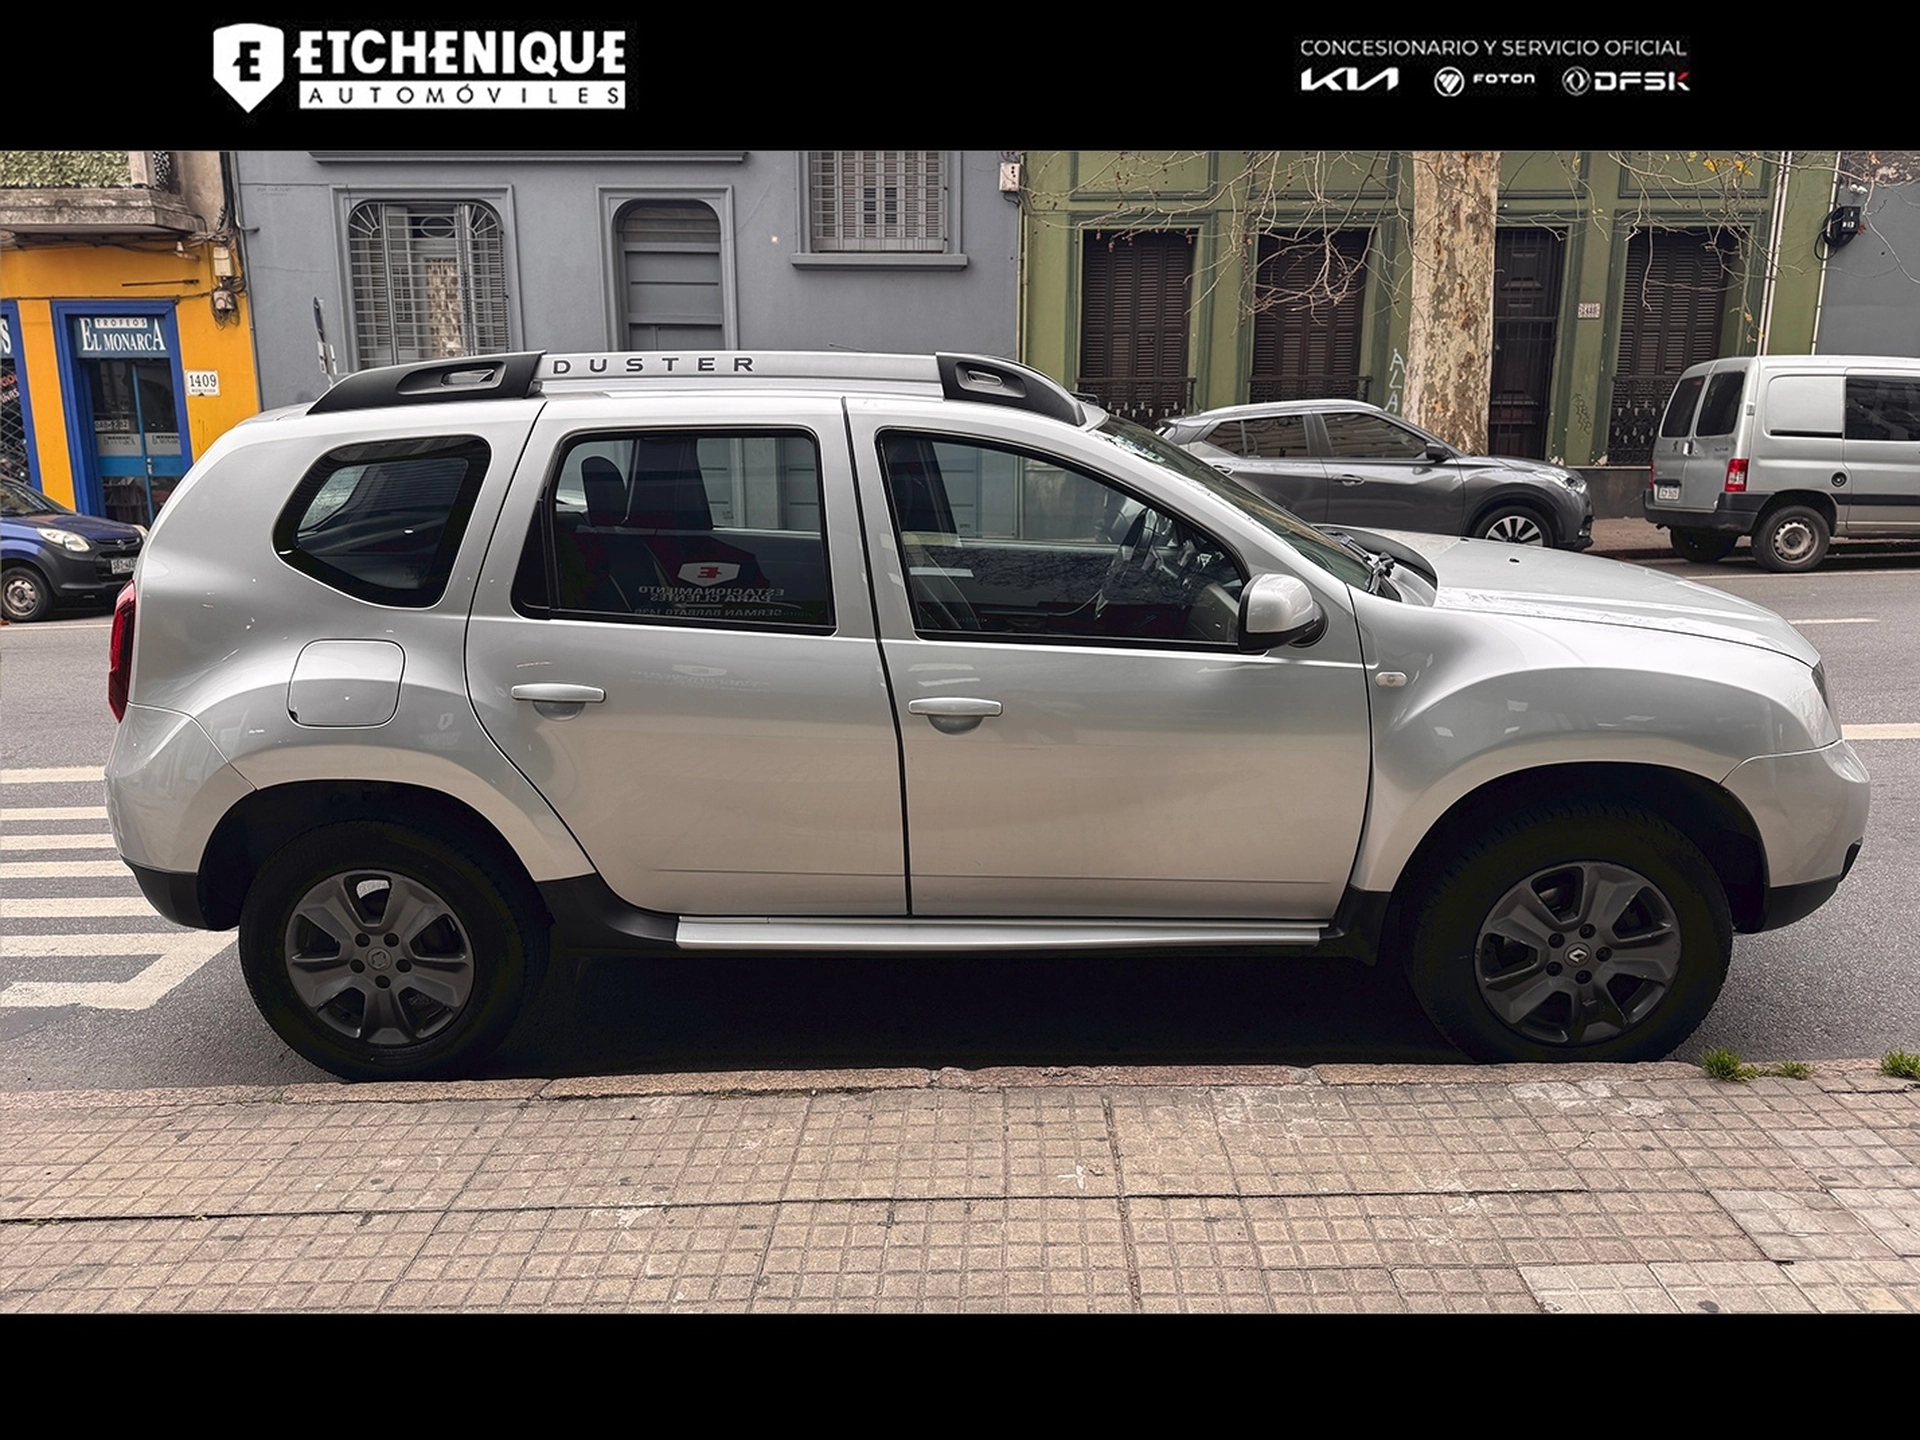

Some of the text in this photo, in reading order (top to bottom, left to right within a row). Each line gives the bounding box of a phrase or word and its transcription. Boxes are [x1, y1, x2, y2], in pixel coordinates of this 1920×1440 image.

[97, 319, 146, 327] TROFEOS
[553, 357, 754, 374] DUSTER
[189, 373, 217, 388] 1409
